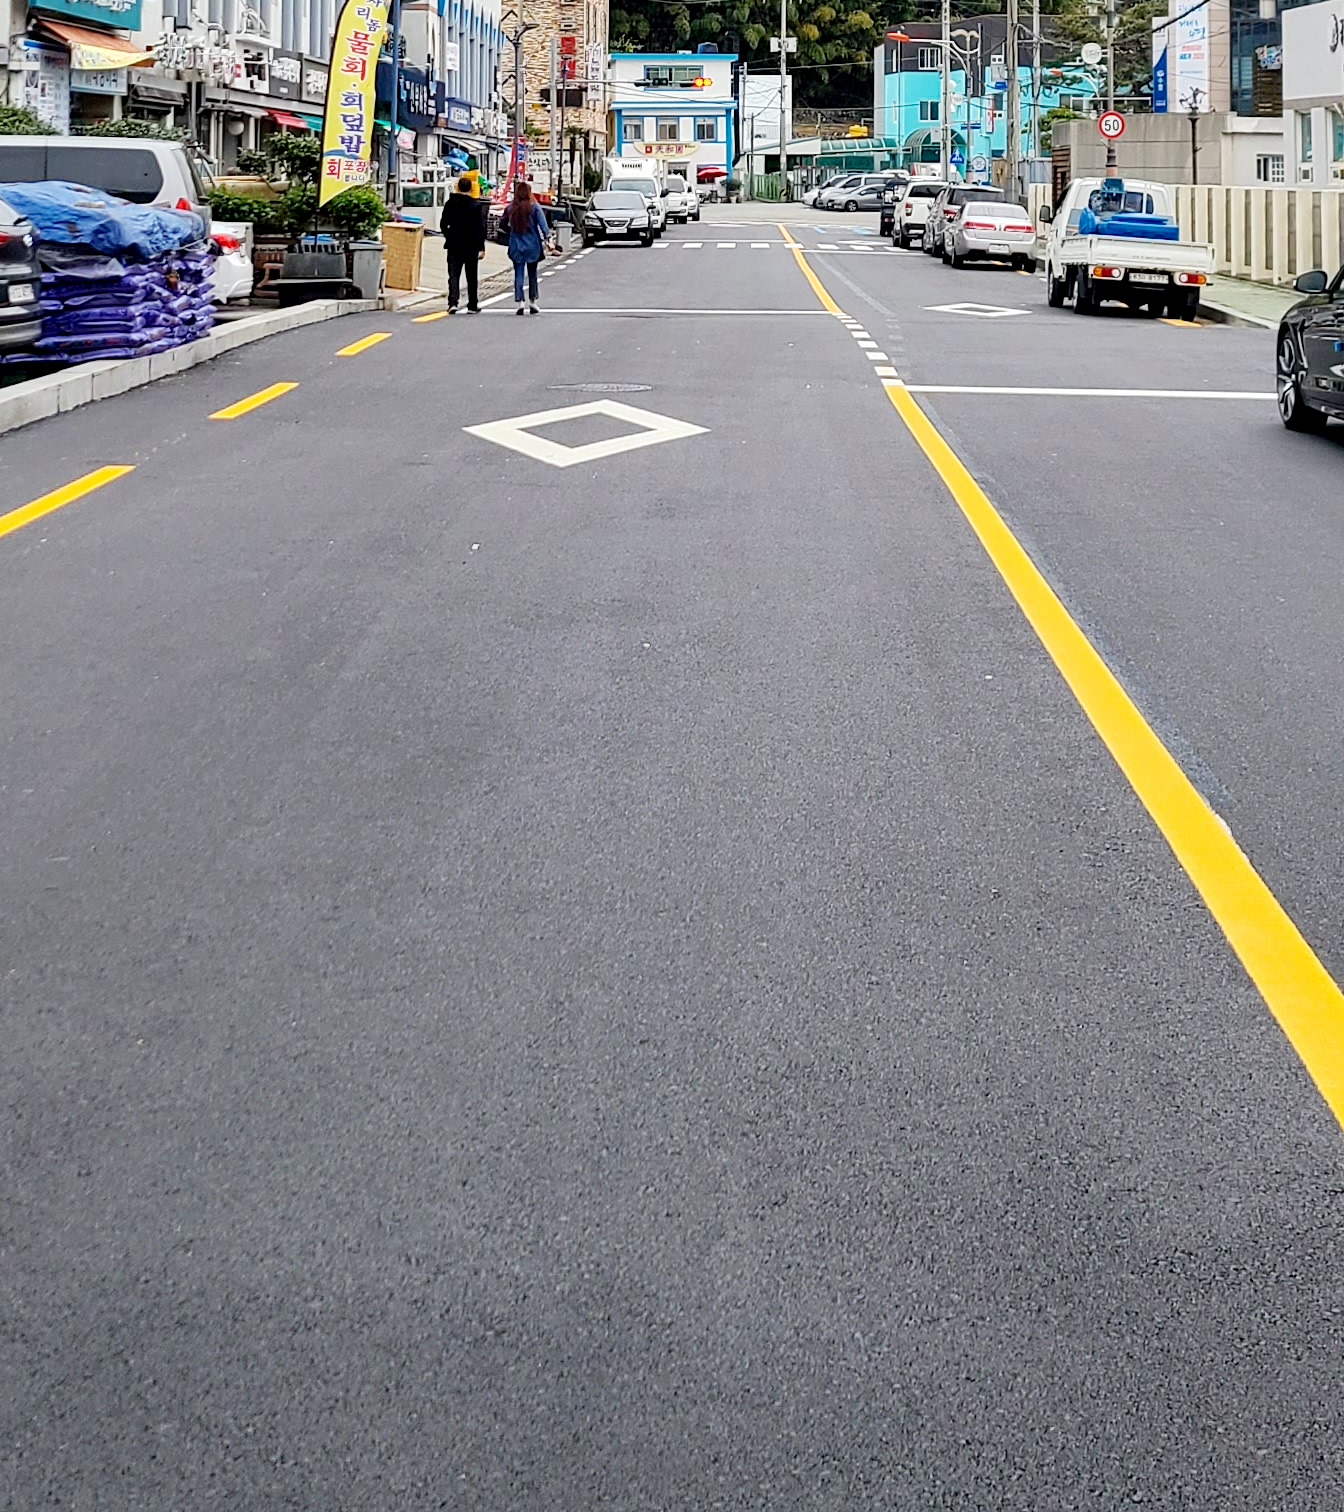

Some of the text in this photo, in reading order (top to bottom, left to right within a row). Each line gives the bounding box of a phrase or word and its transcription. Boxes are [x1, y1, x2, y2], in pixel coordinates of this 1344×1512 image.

[340, 30, 376, 81] 물회
[338, 91, 366, 154] 회덮밥
[1104, 119, 1120, 131] 50
[326, 158, 342, 180] 회
